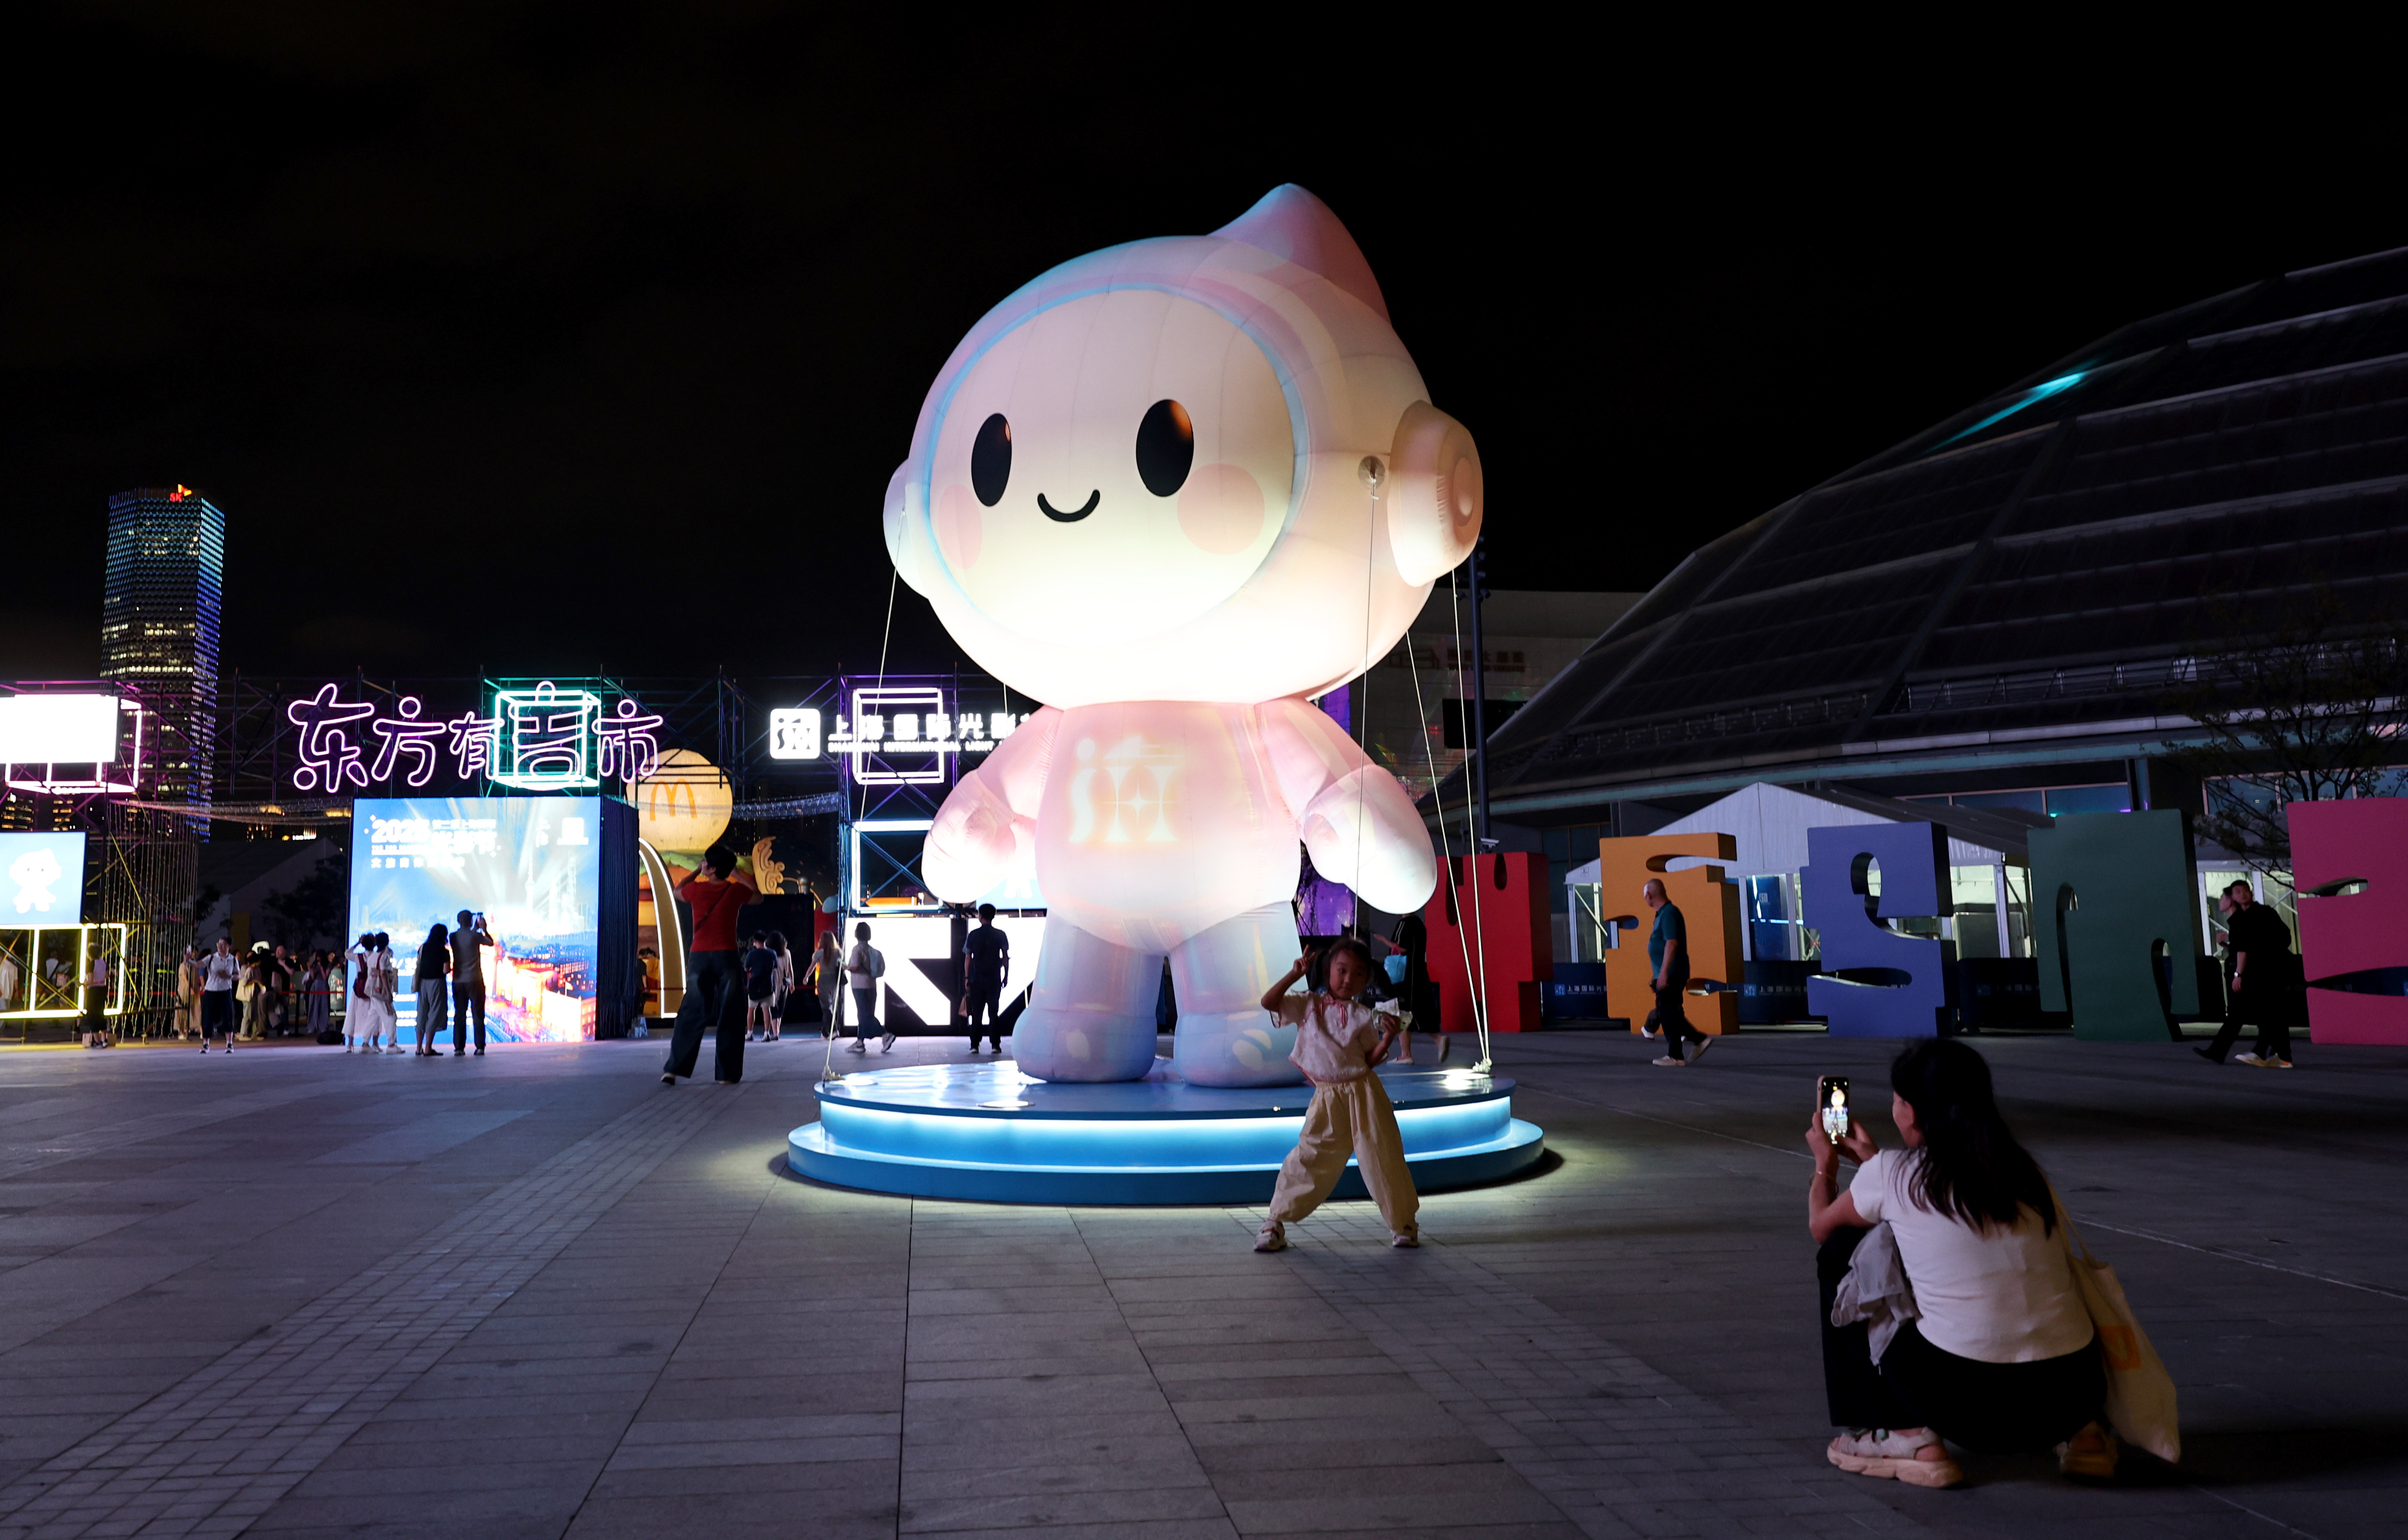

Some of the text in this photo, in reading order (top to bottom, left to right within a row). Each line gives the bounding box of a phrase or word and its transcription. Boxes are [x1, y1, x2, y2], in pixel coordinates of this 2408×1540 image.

[170, 492, 183, 502] SK
[828, 713, 1030, 741] 上海国际光影
